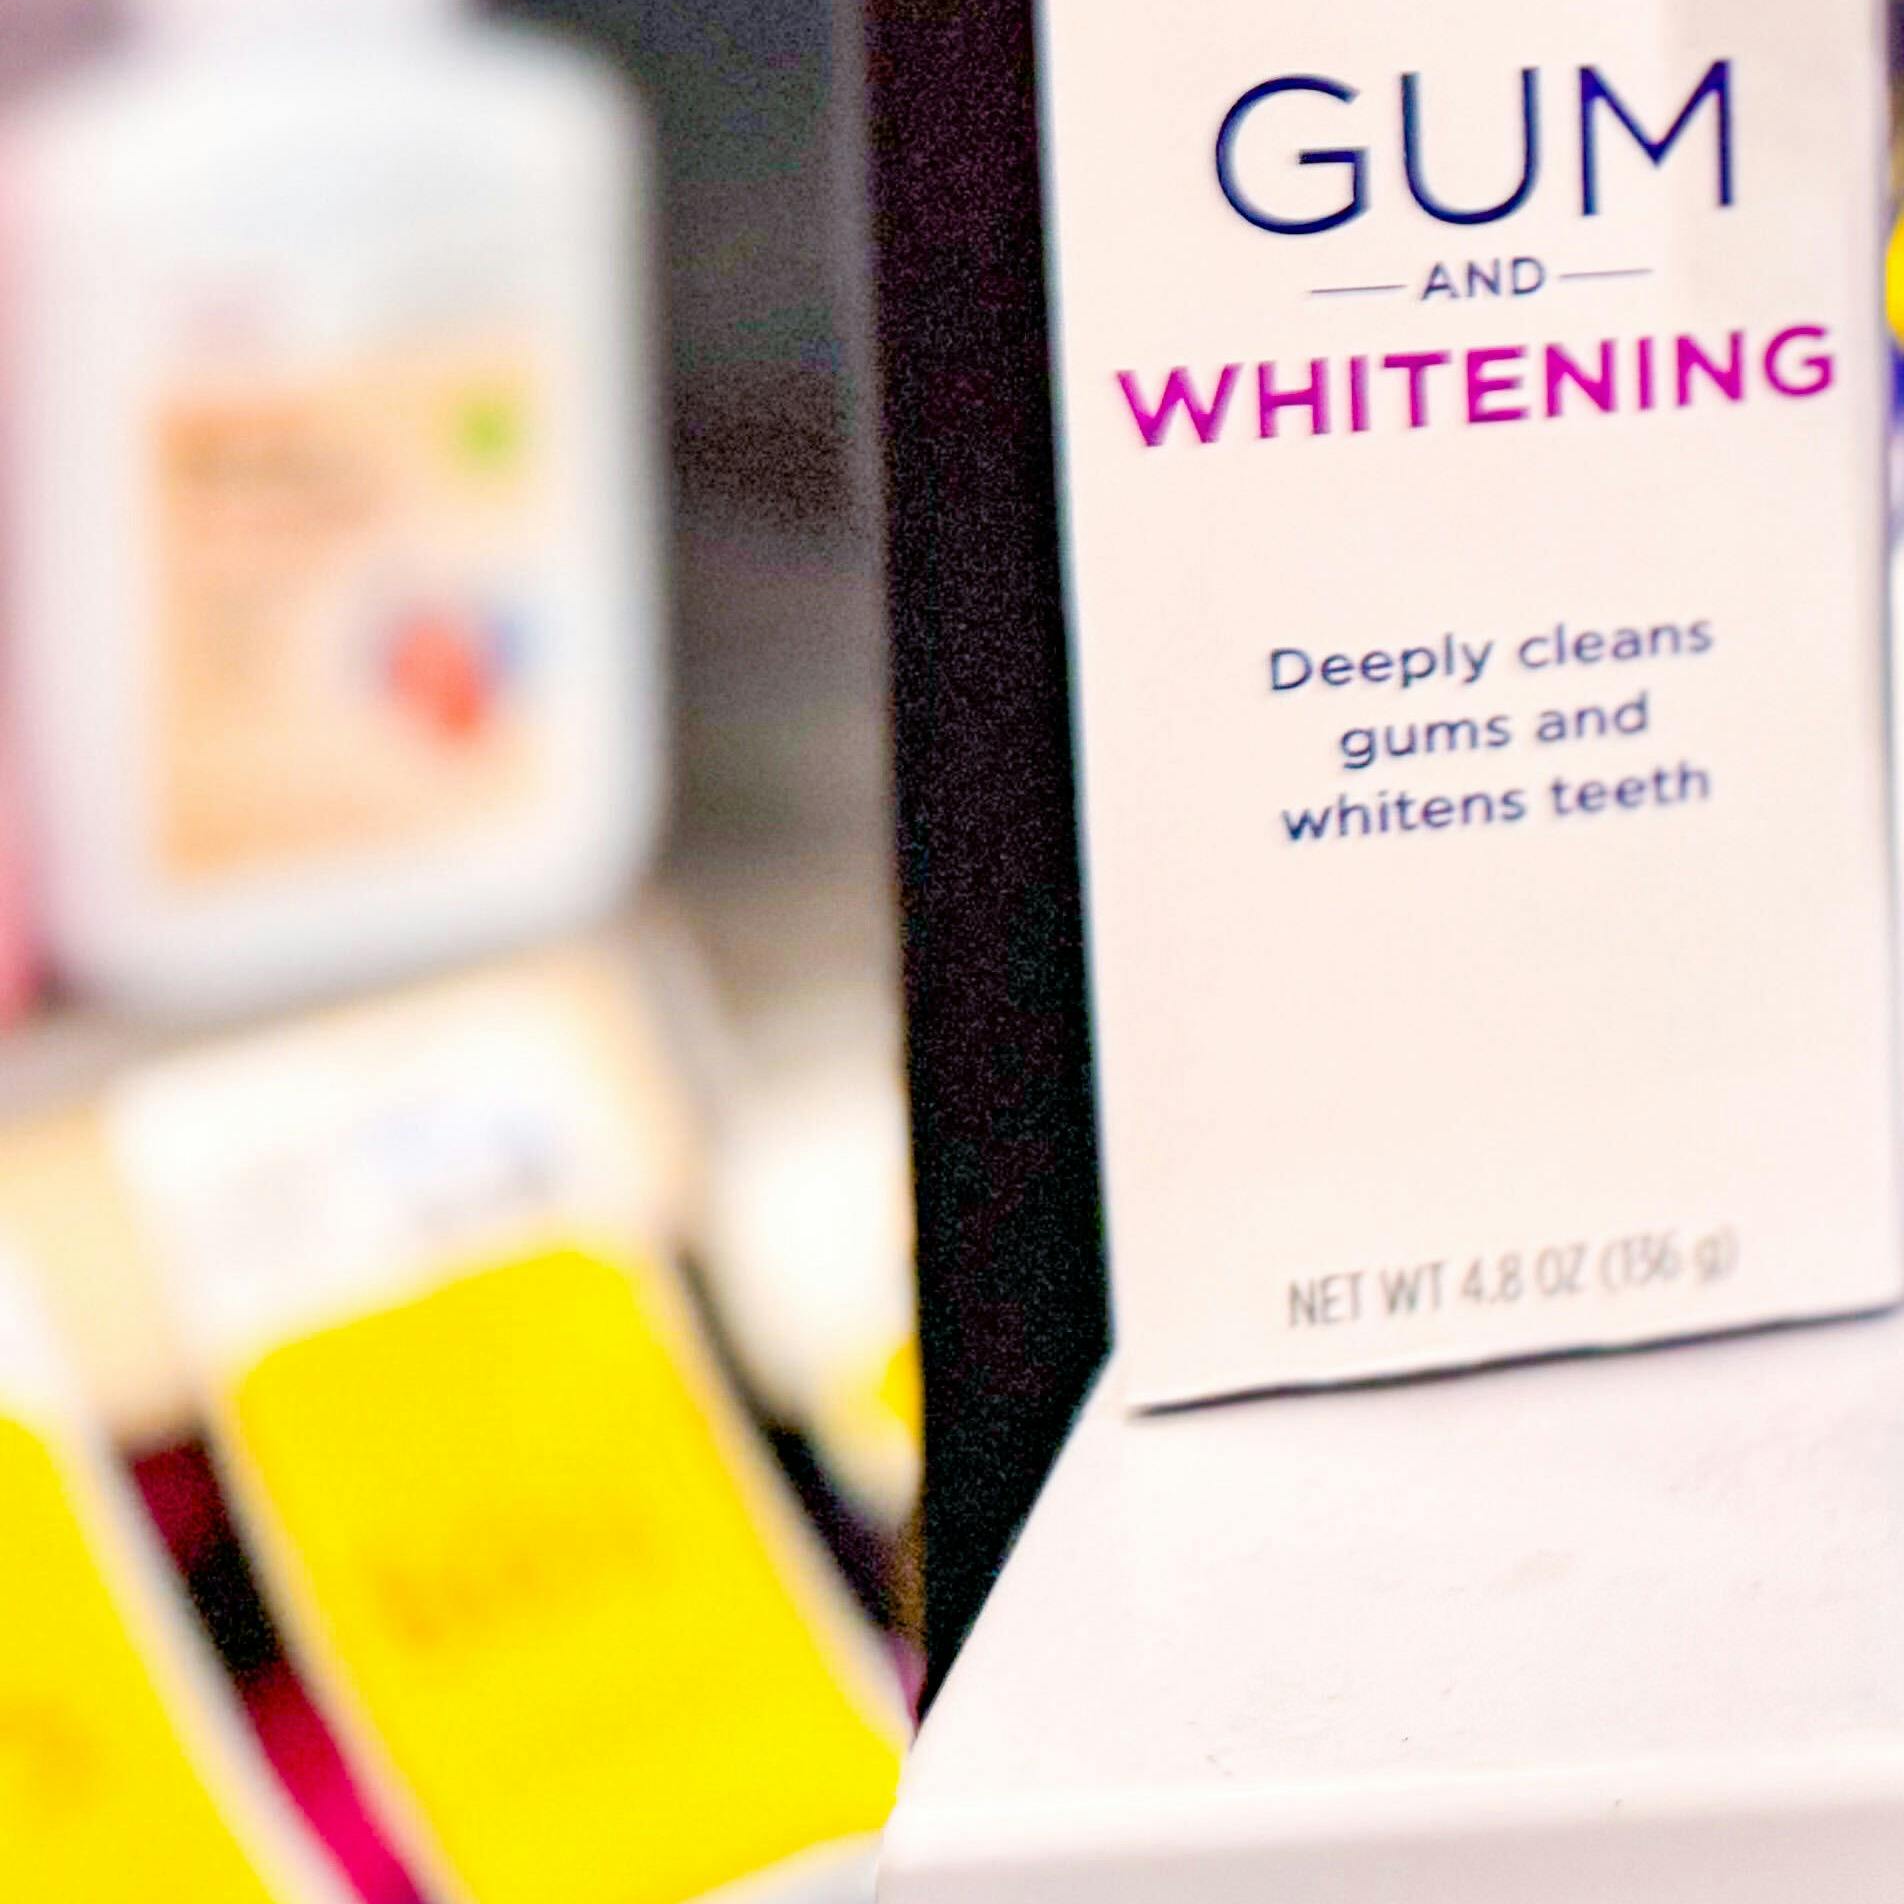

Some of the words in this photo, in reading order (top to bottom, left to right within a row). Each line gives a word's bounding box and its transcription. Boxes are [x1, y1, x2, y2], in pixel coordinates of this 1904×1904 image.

[1211, 59, 1738, 236] GUM
[1419, 256, 1547, 301] AND
[1113, 323, 1837, 449] WHITENING
[1268, 632, 1494, 690] Deeply
[1517, 619, 1714, 671] cleans
[1338, 712, 1513, 771] gums
[1534, 689, 1651, 745] and
[1281, 786, 1528, 843] whitens
[1548, 760, 1713, 818] teeth
[1288, 1269, 1366, 1329] NET
[1378, 1259, 1448, 1316] WT
[1460, 1250, 1523, 1306] 4.8
[1534, 1241, 1589, 1295] OZ
[1599, 1228, 1684, 1293] (136
[1694, 1223, 1740, 1284] g)
